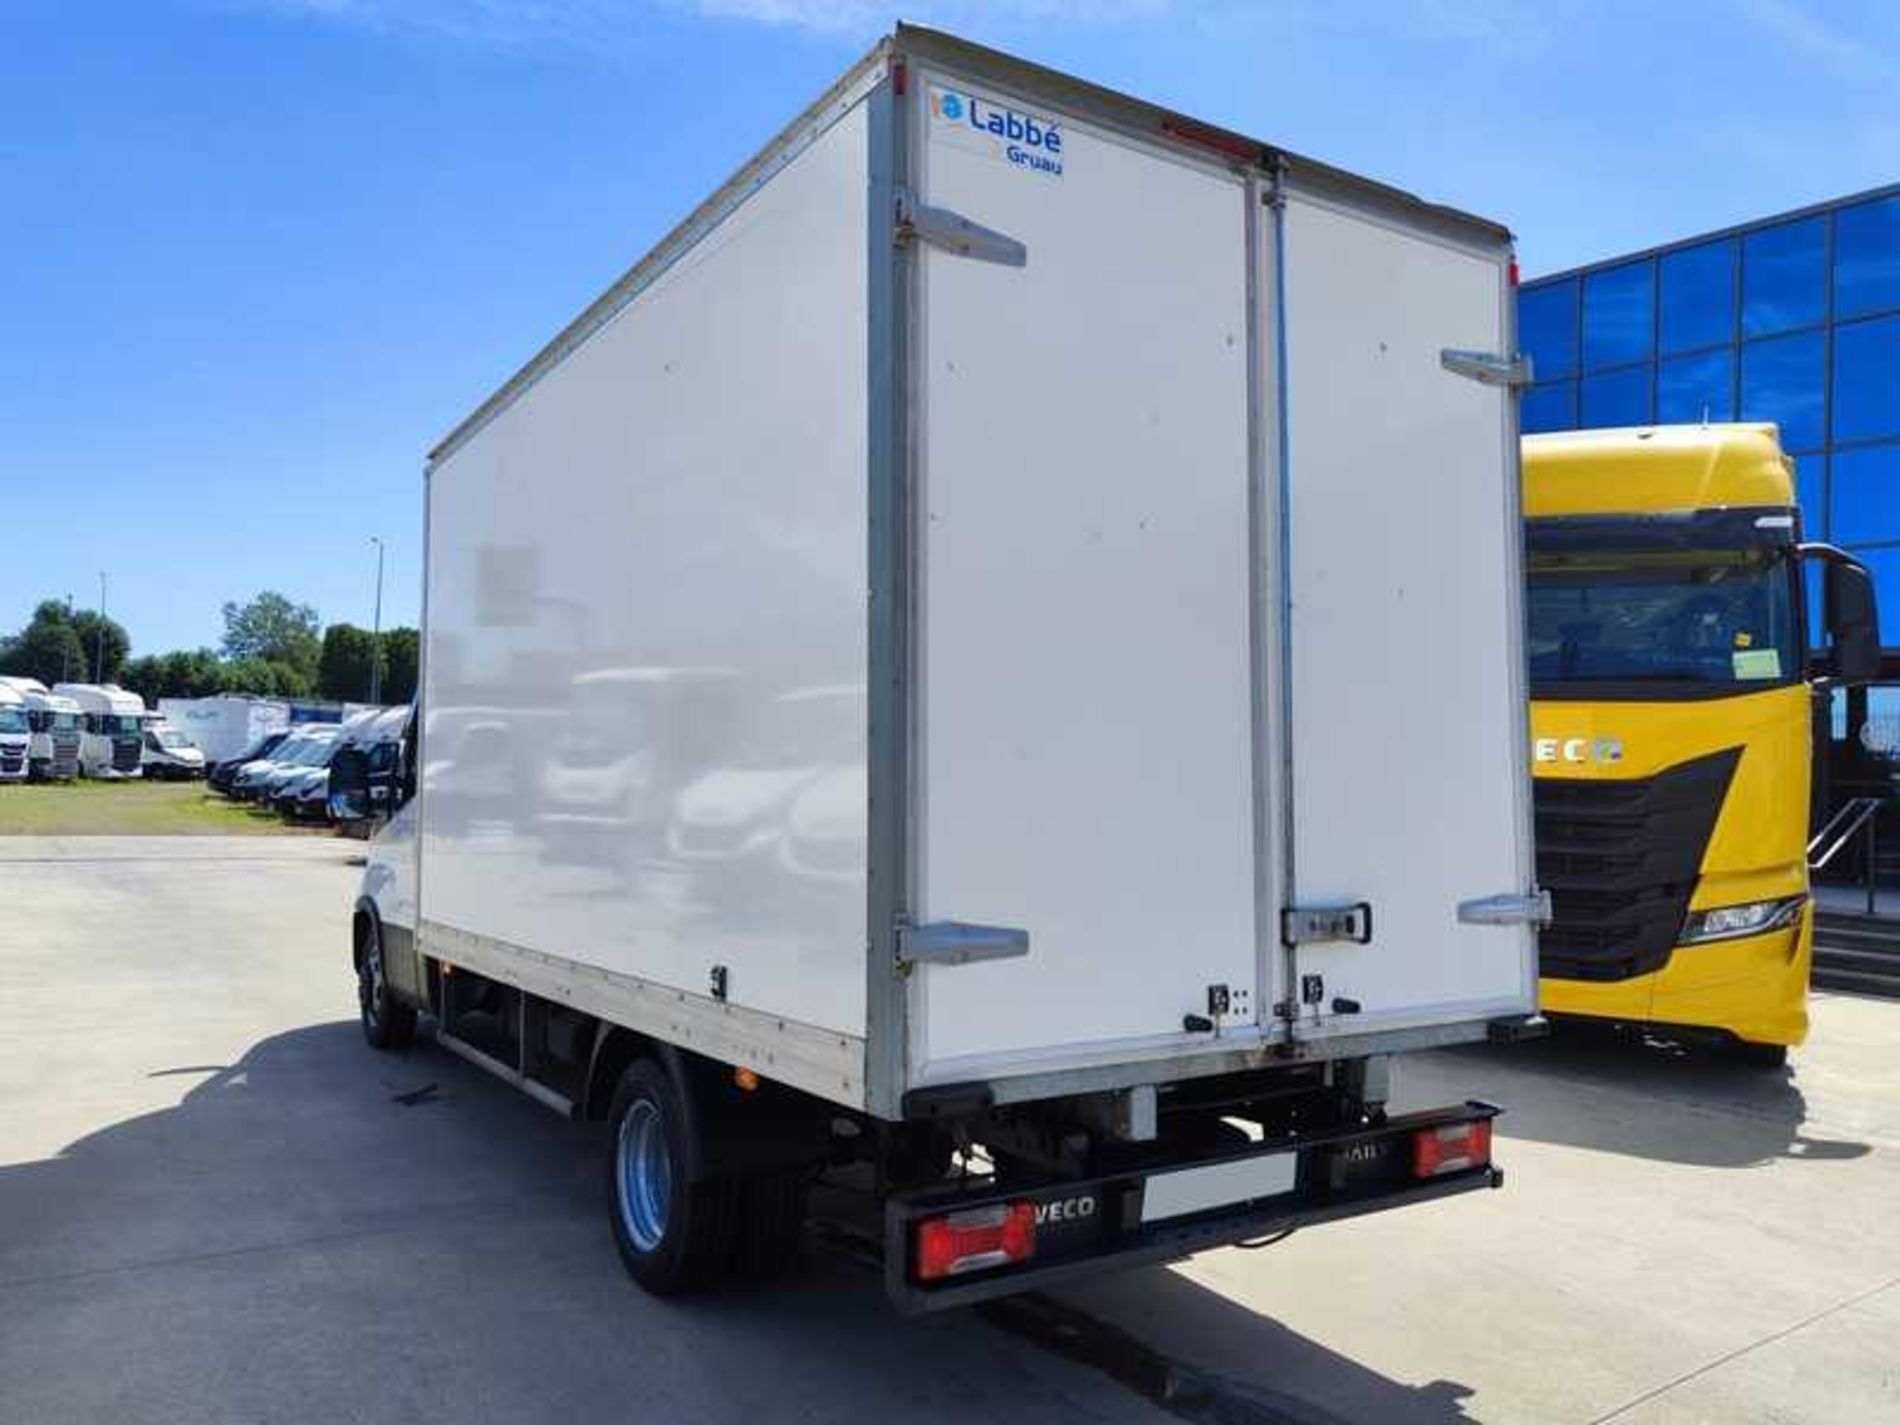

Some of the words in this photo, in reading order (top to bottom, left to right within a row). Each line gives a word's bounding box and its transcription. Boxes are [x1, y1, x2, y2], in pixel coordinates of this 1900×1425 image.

[970, 99, 1061, 153] Labbé
[1006, 145, 1062, 175] Gruau
[1535, 737, 1622, 763] ECO
[1033, 1196, 1096, 1224] VECO
